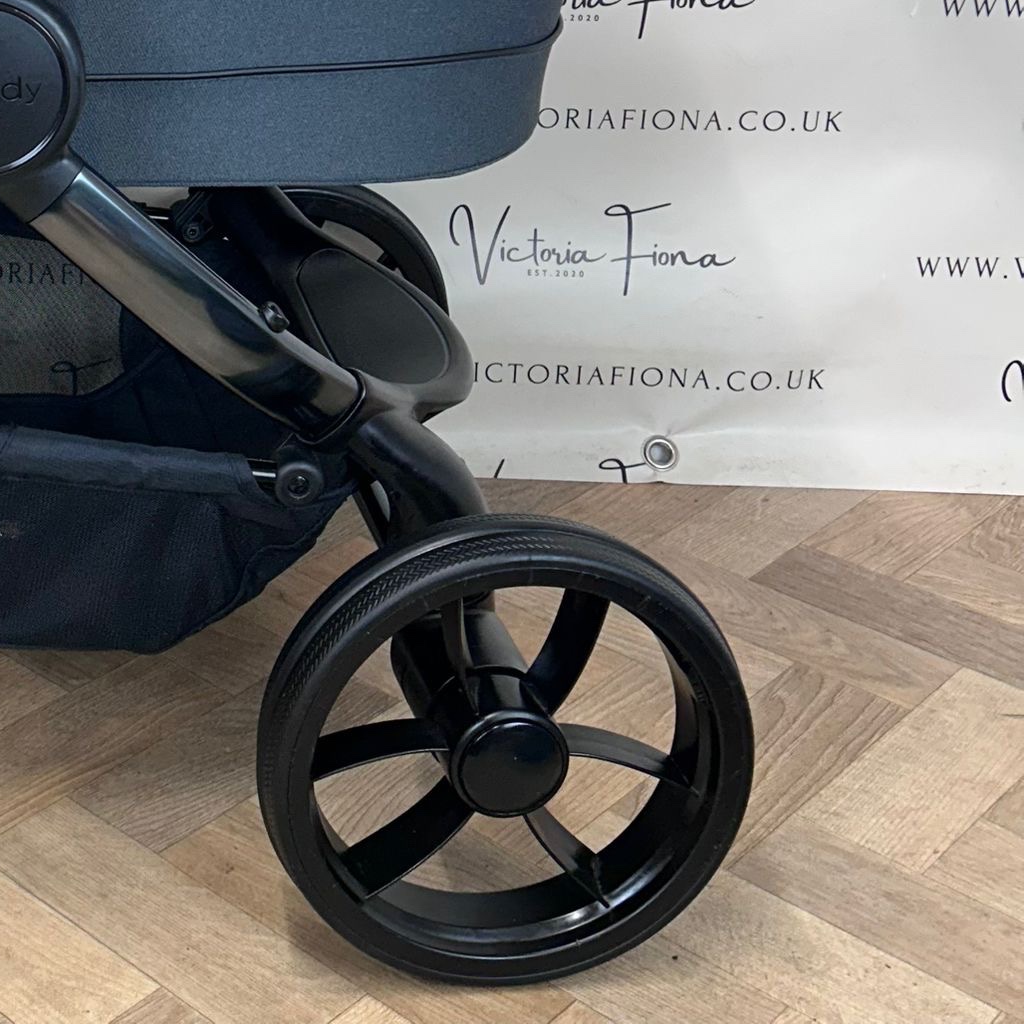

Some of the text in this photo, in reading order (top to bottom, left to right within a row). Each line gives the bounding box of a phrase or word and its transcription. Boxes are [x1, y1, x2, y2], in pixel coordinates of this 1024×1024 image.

[448, 202, 737, 297] Victoria Fiona
[527, 268, 586, 278] EST.2020
